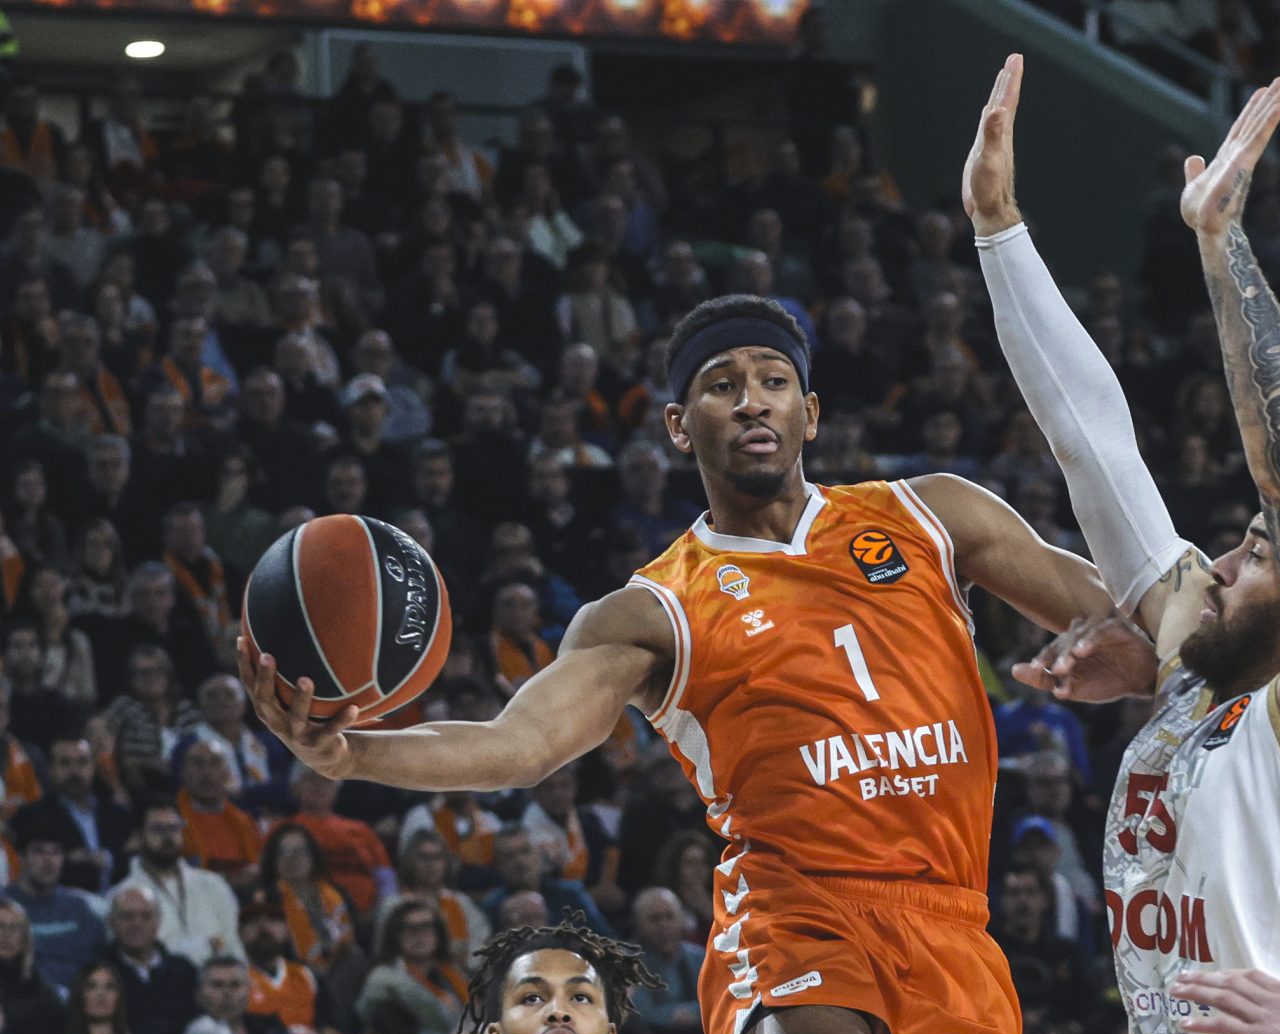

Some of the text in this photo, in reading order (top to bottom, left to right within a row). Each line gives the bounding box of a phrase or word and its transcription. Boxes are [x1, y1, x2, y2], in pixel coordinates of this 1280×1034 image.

[833, 623, 880, 702] 1
[799, 719, 968, 786] VALENCIA
[859, 773, 939, 801] BASET
[1106, 888, 1214, 963] DCOM
